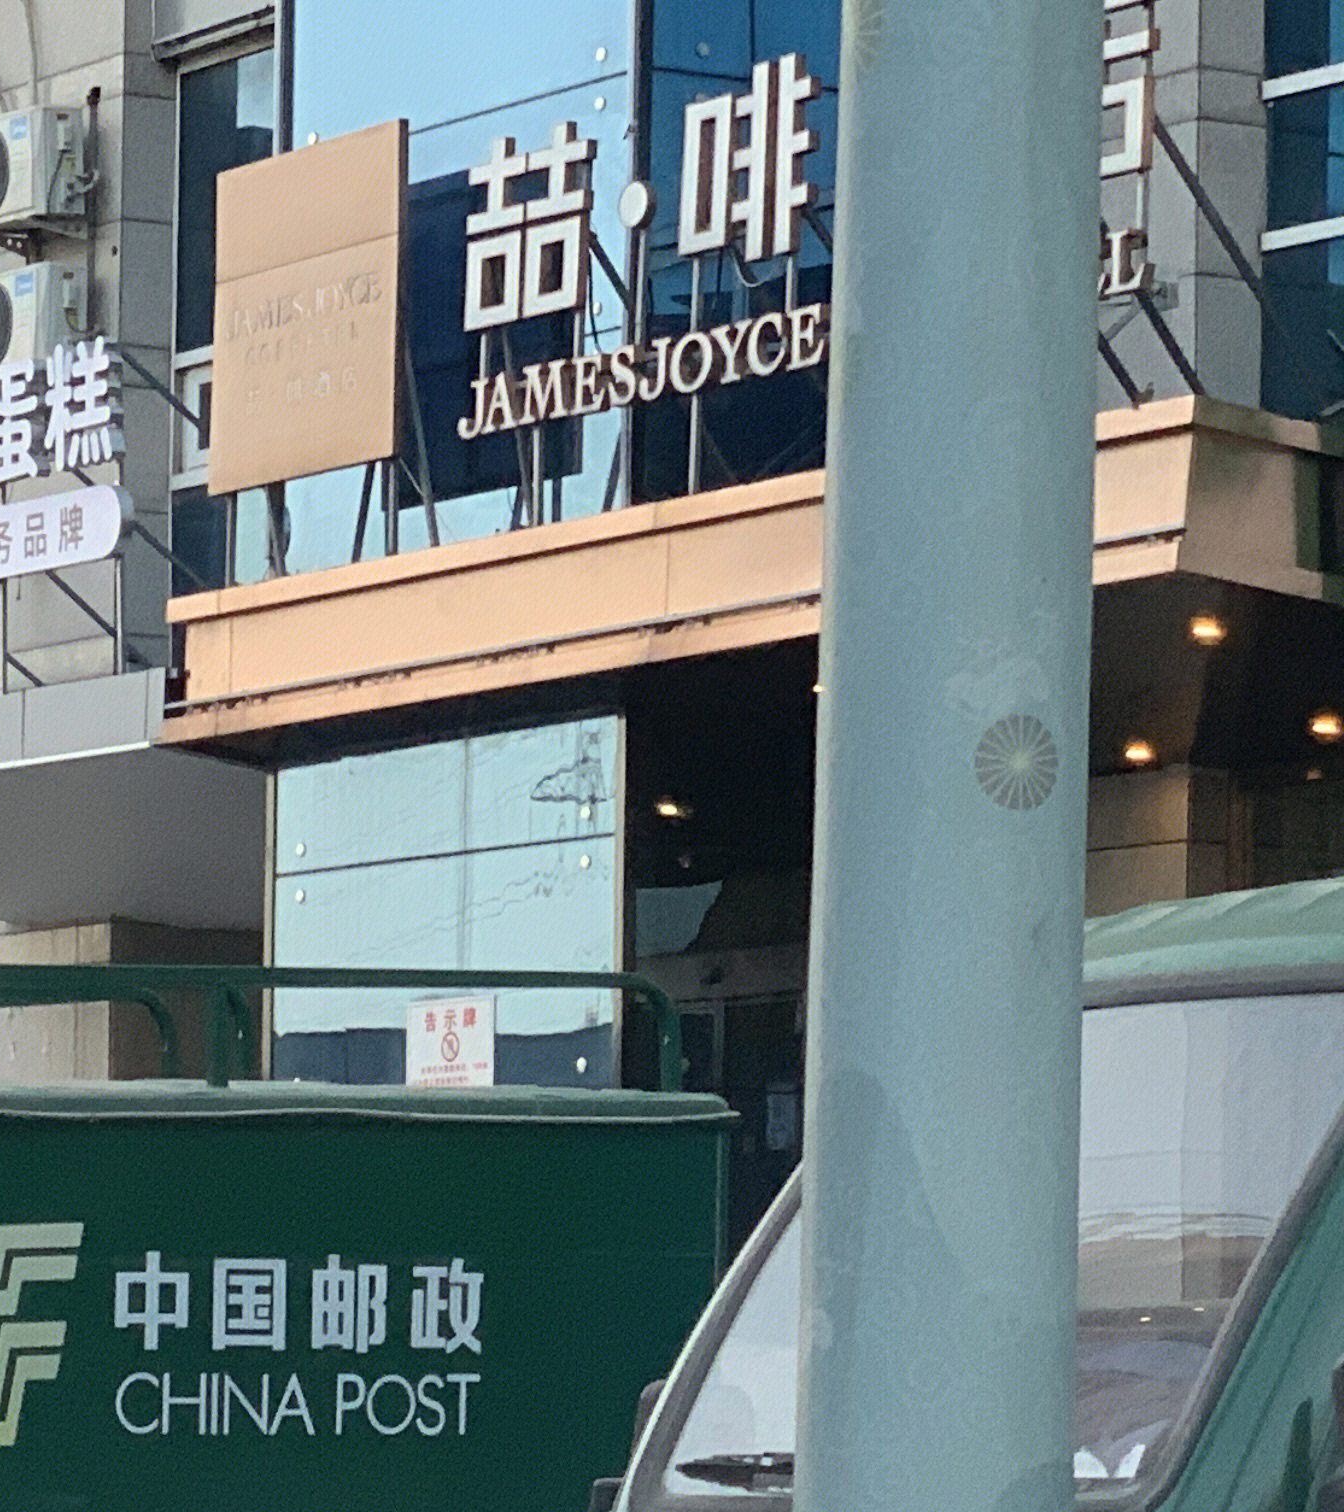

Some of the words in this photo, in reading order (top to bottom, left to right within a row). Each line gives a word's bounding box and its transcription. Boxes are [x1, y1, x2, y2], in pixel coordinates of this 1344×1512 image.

[113, 1250, 485, 1355] 中国邮政
[114, 1371, 315, 1438] CHINA
[335, 1372, 481, 1438] POST
